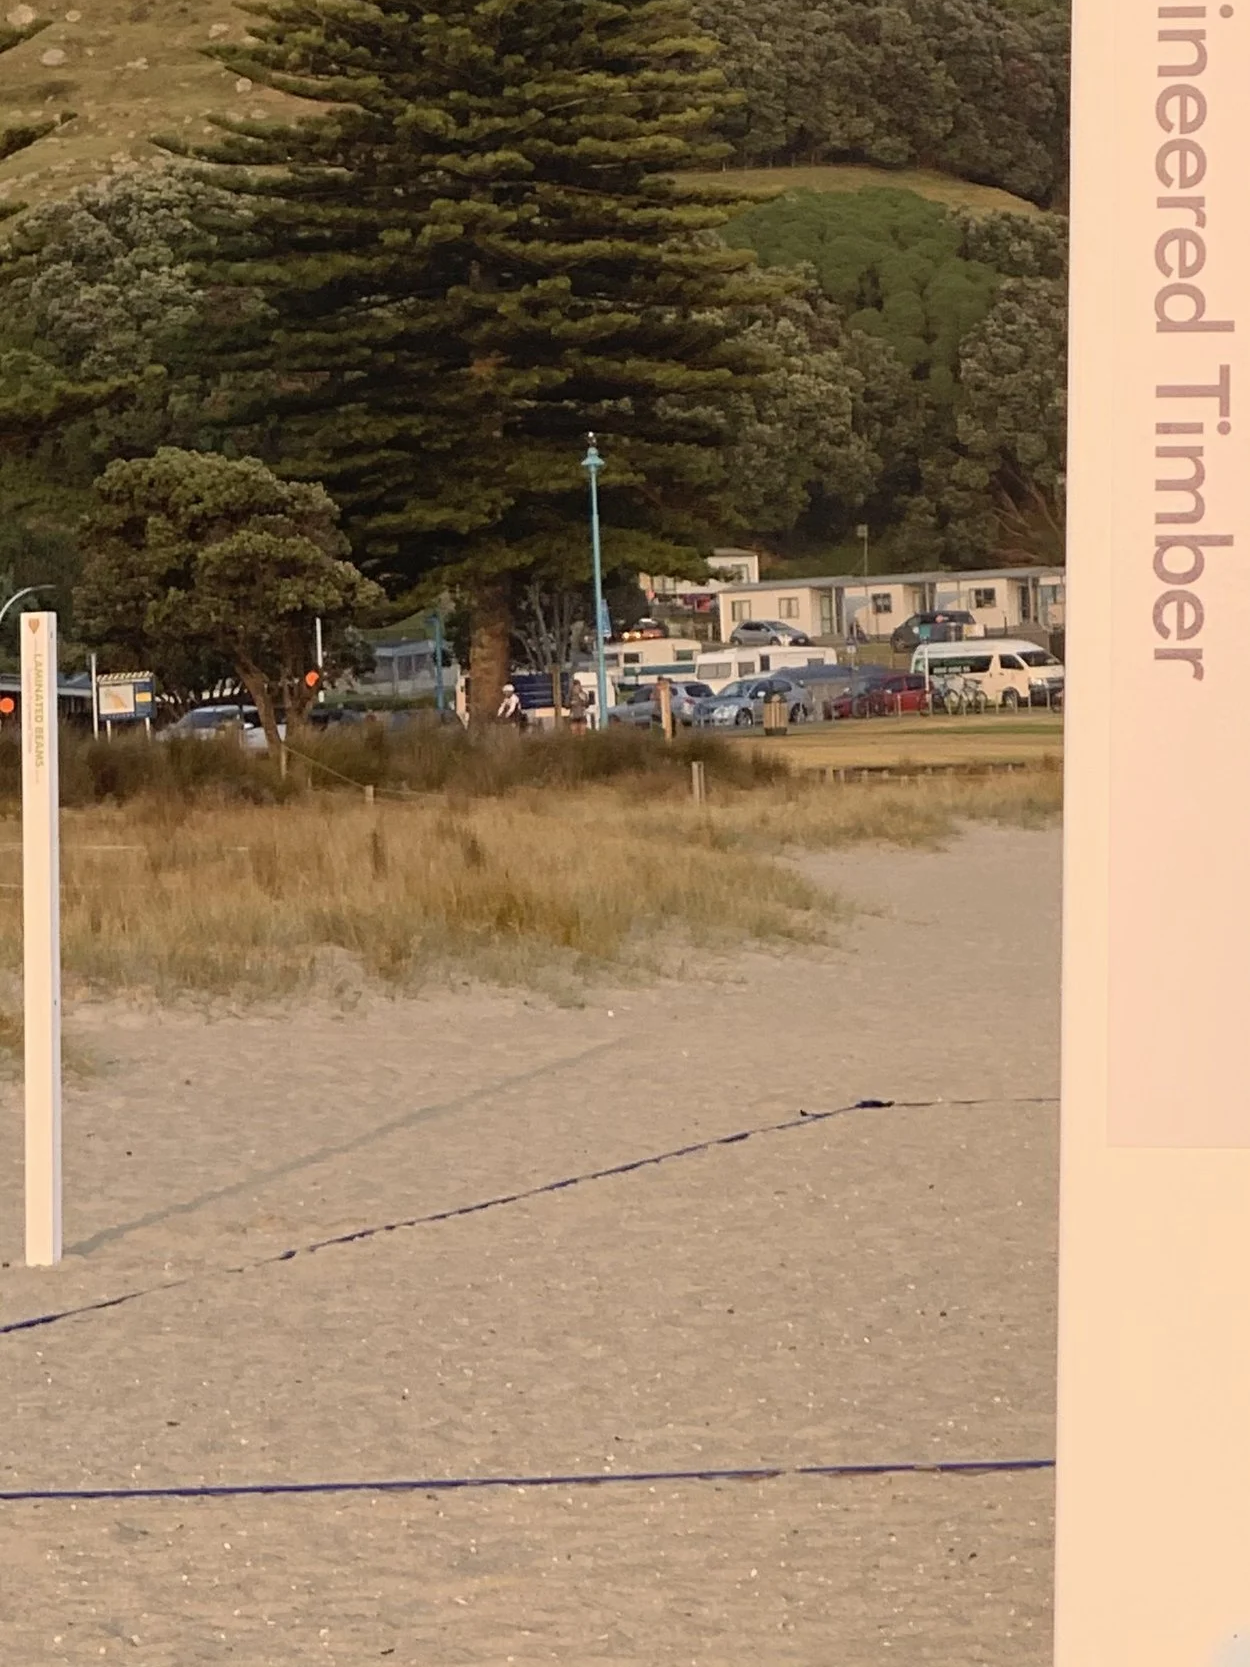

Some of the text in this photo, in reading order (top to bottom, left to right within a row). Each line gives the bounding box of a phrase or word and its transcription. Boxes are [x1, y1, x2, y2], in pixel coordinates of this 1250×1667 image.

[1152, 364, 1234, 681] Timber
[34, 653, 45, 768] LAMINATED BEAMS
